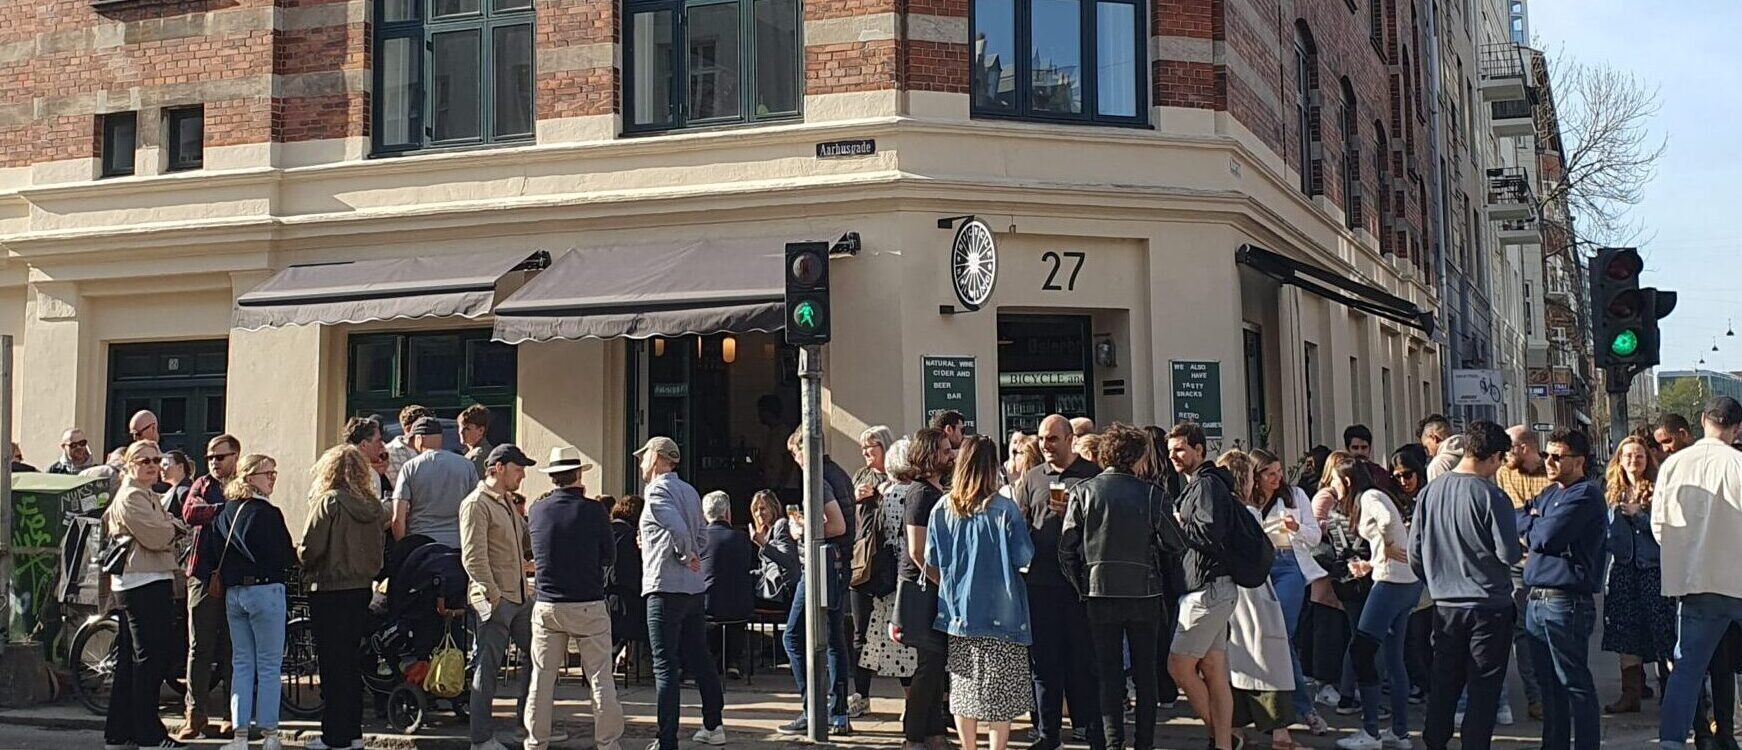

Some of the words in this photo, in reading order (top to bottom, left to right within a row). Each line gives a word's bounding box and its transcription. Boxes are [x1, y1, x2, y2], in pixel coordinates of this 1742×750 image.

[820, 141, 872, 156] Aarhusgade
[1041, 251, 1086, 291] 27
[1010, 373, 1065, 384] BICYCLE
[1182, 382, 1204, 390] TASTY
[946, 392, 962, 400] BAR
